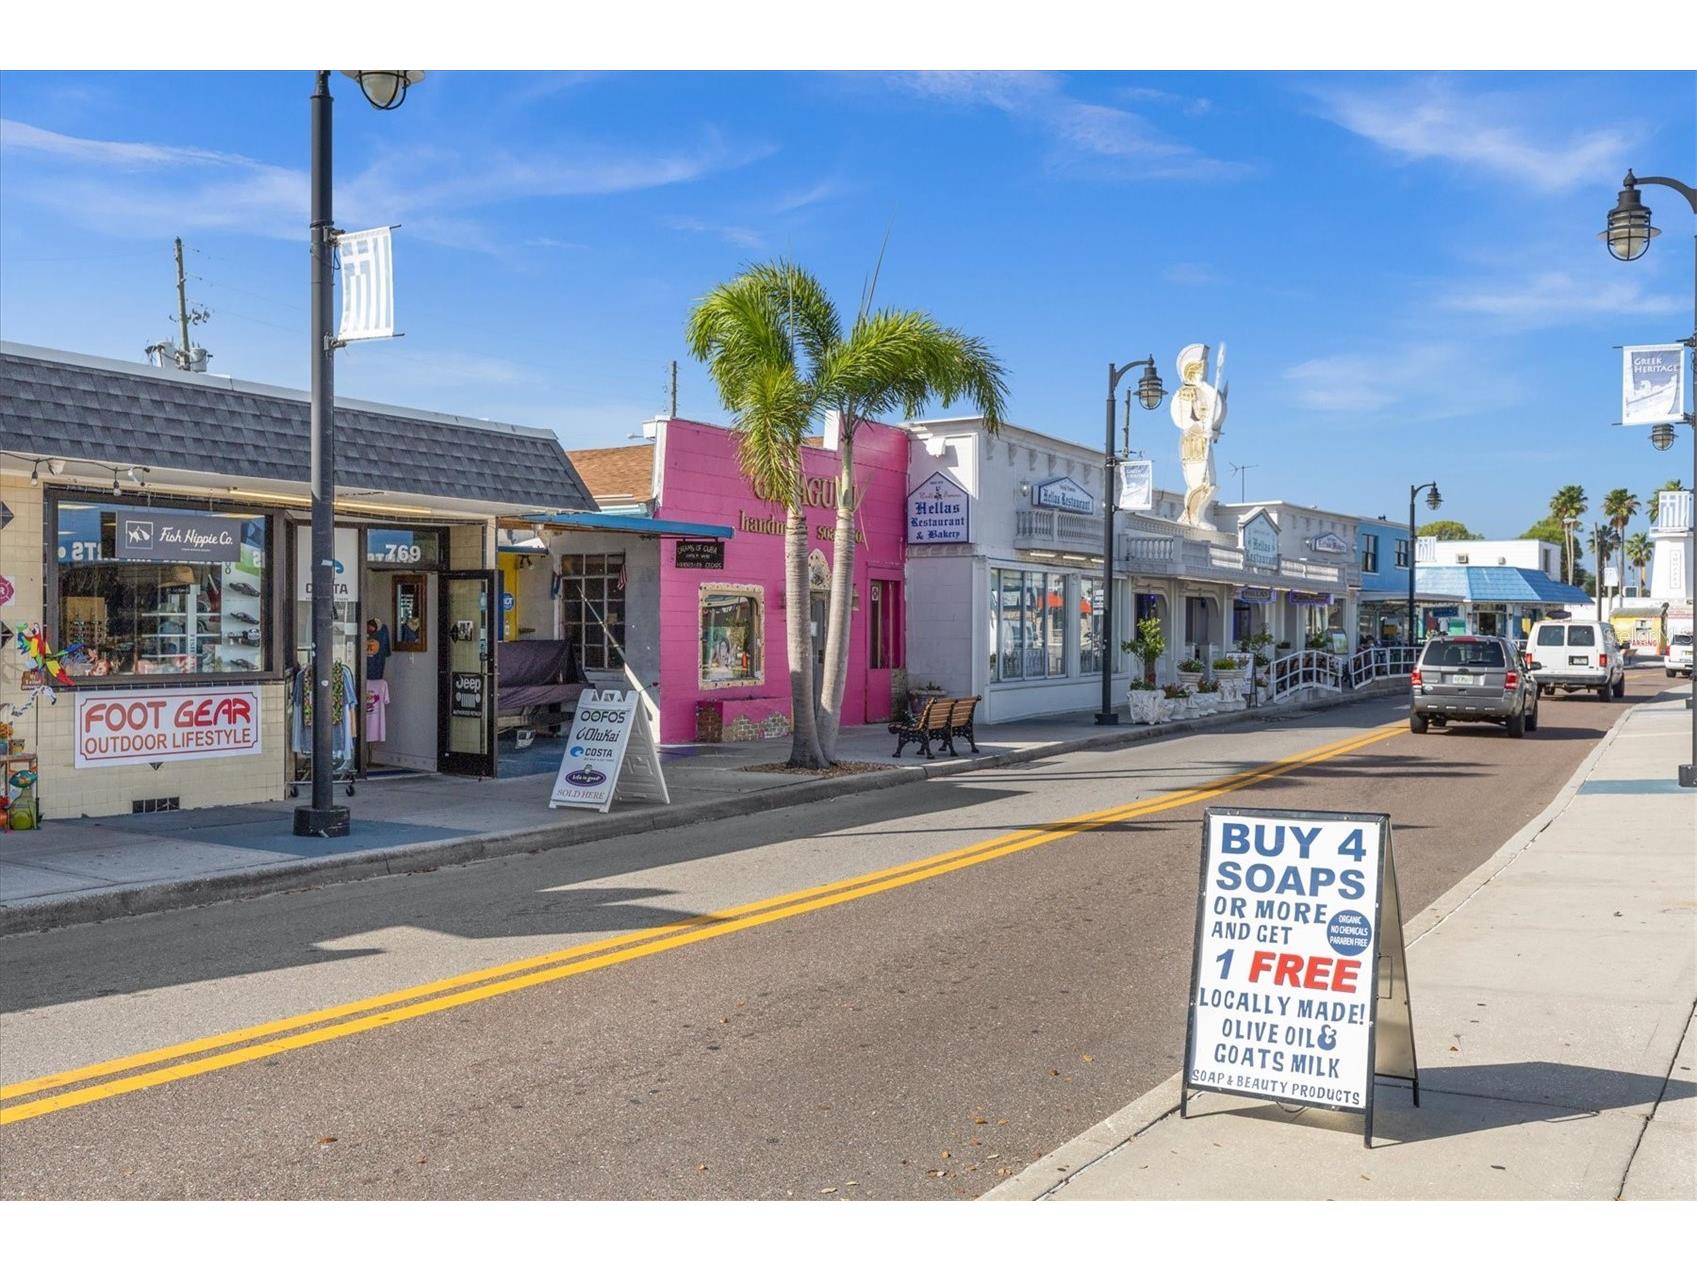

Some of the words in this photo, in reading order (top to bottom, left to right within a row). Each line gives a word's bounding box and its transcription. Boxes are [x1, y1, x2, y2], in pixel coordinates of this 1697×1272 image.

[1633, 357, 1663, 366] GREEK
[1634, 364, 1678, 373] HERITAGE
[915, 501, 960, 515] Hellas
[911, 516, 965, 527] Restaurant
[159, 526, 182, 543] Fish
[183, 528, 218, 548] Hippie
[219, 531, 233, 545] Co.
[915, 531, 924, 540] &
[928, 530, 960, 540] Bakery
[385, 544, 421, 562] 769
[305, 583, 348, 594] CTA
[455, 674, 482, 693] Jeep
[85, 701, 167, 733] FOOT
[174, 698, 251, 728] GEAR
[580, 710, 626, 724] OOFOS
[85, 733, 167, 755] OUTDOOR
[172, 728, 251, 748] LIFESTYLE
[584, 728, 621, 742] OluKai
[584, 747, 613, 758] COSTA
[580, 790, 605, 800] HERE
[1221, 822, 1323, 859] BUY
[1337, 828, 1367, 863] 4
[1216, 861, 1365, 900] SOAPS
[1213, 896, 1247, 919] OR
[1255, 900, 1328, 925] MORE
[1338, 914, 1362, 924] ORGANIC
[1211, 921, 1251, 940] AND
[1257, 925, 1293, 945] GET
[1330, 925, 1339, 934] NO
[1339, 926, 1368, 936] CHEMICALS
[1329, 936, 1354, 946] PARABEN
[1354, 938, 1368, 947] FREE
[1215, 948, 1235, 980] 1
[1248, 950, 1362, 994] FREE
[1199, 987, 1291, 1016] LOCALLY
[1297, 999, 1365, 1025] MADE!
[1222, 1018, 1279, 1044] OLIVE
[1214, 1043, 1285, 1072] GOATS
[1290, 1054, 1340, 1079] MILK
[1191, 1069, 1225, 1085] SOAP
[1226, 1075, 1234, 1086] &
[1236, 1076, 1288, 1094] BEAUTY
[1292, 1083, 1360, 1106] PRODUCTS
